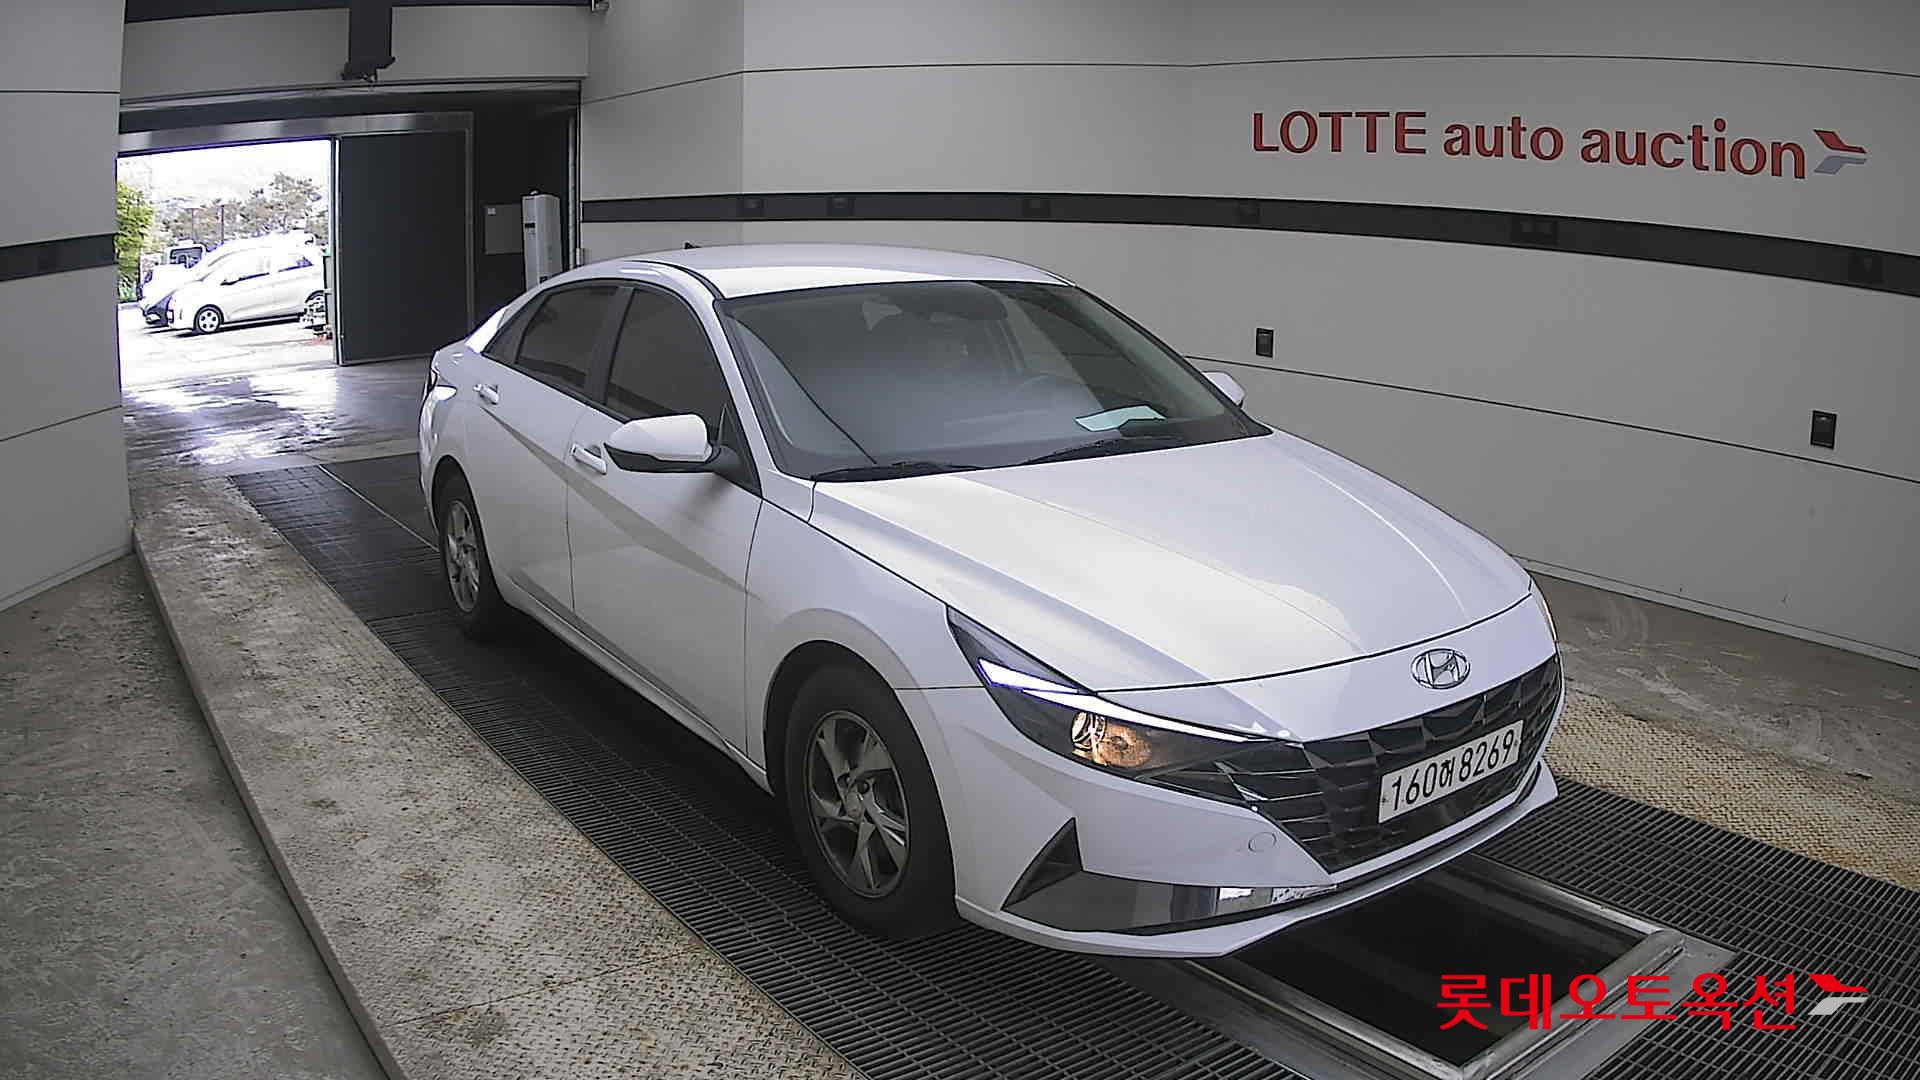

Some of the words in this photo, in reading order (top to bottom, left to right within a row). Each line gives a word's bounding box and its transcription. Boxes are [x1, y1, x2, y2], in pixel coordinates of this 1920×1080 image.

[1253, 111, 1427, 154] LOTTE
[1443, 116, 1564, 161] auto
[1581, 118, 1805, 179] auction
